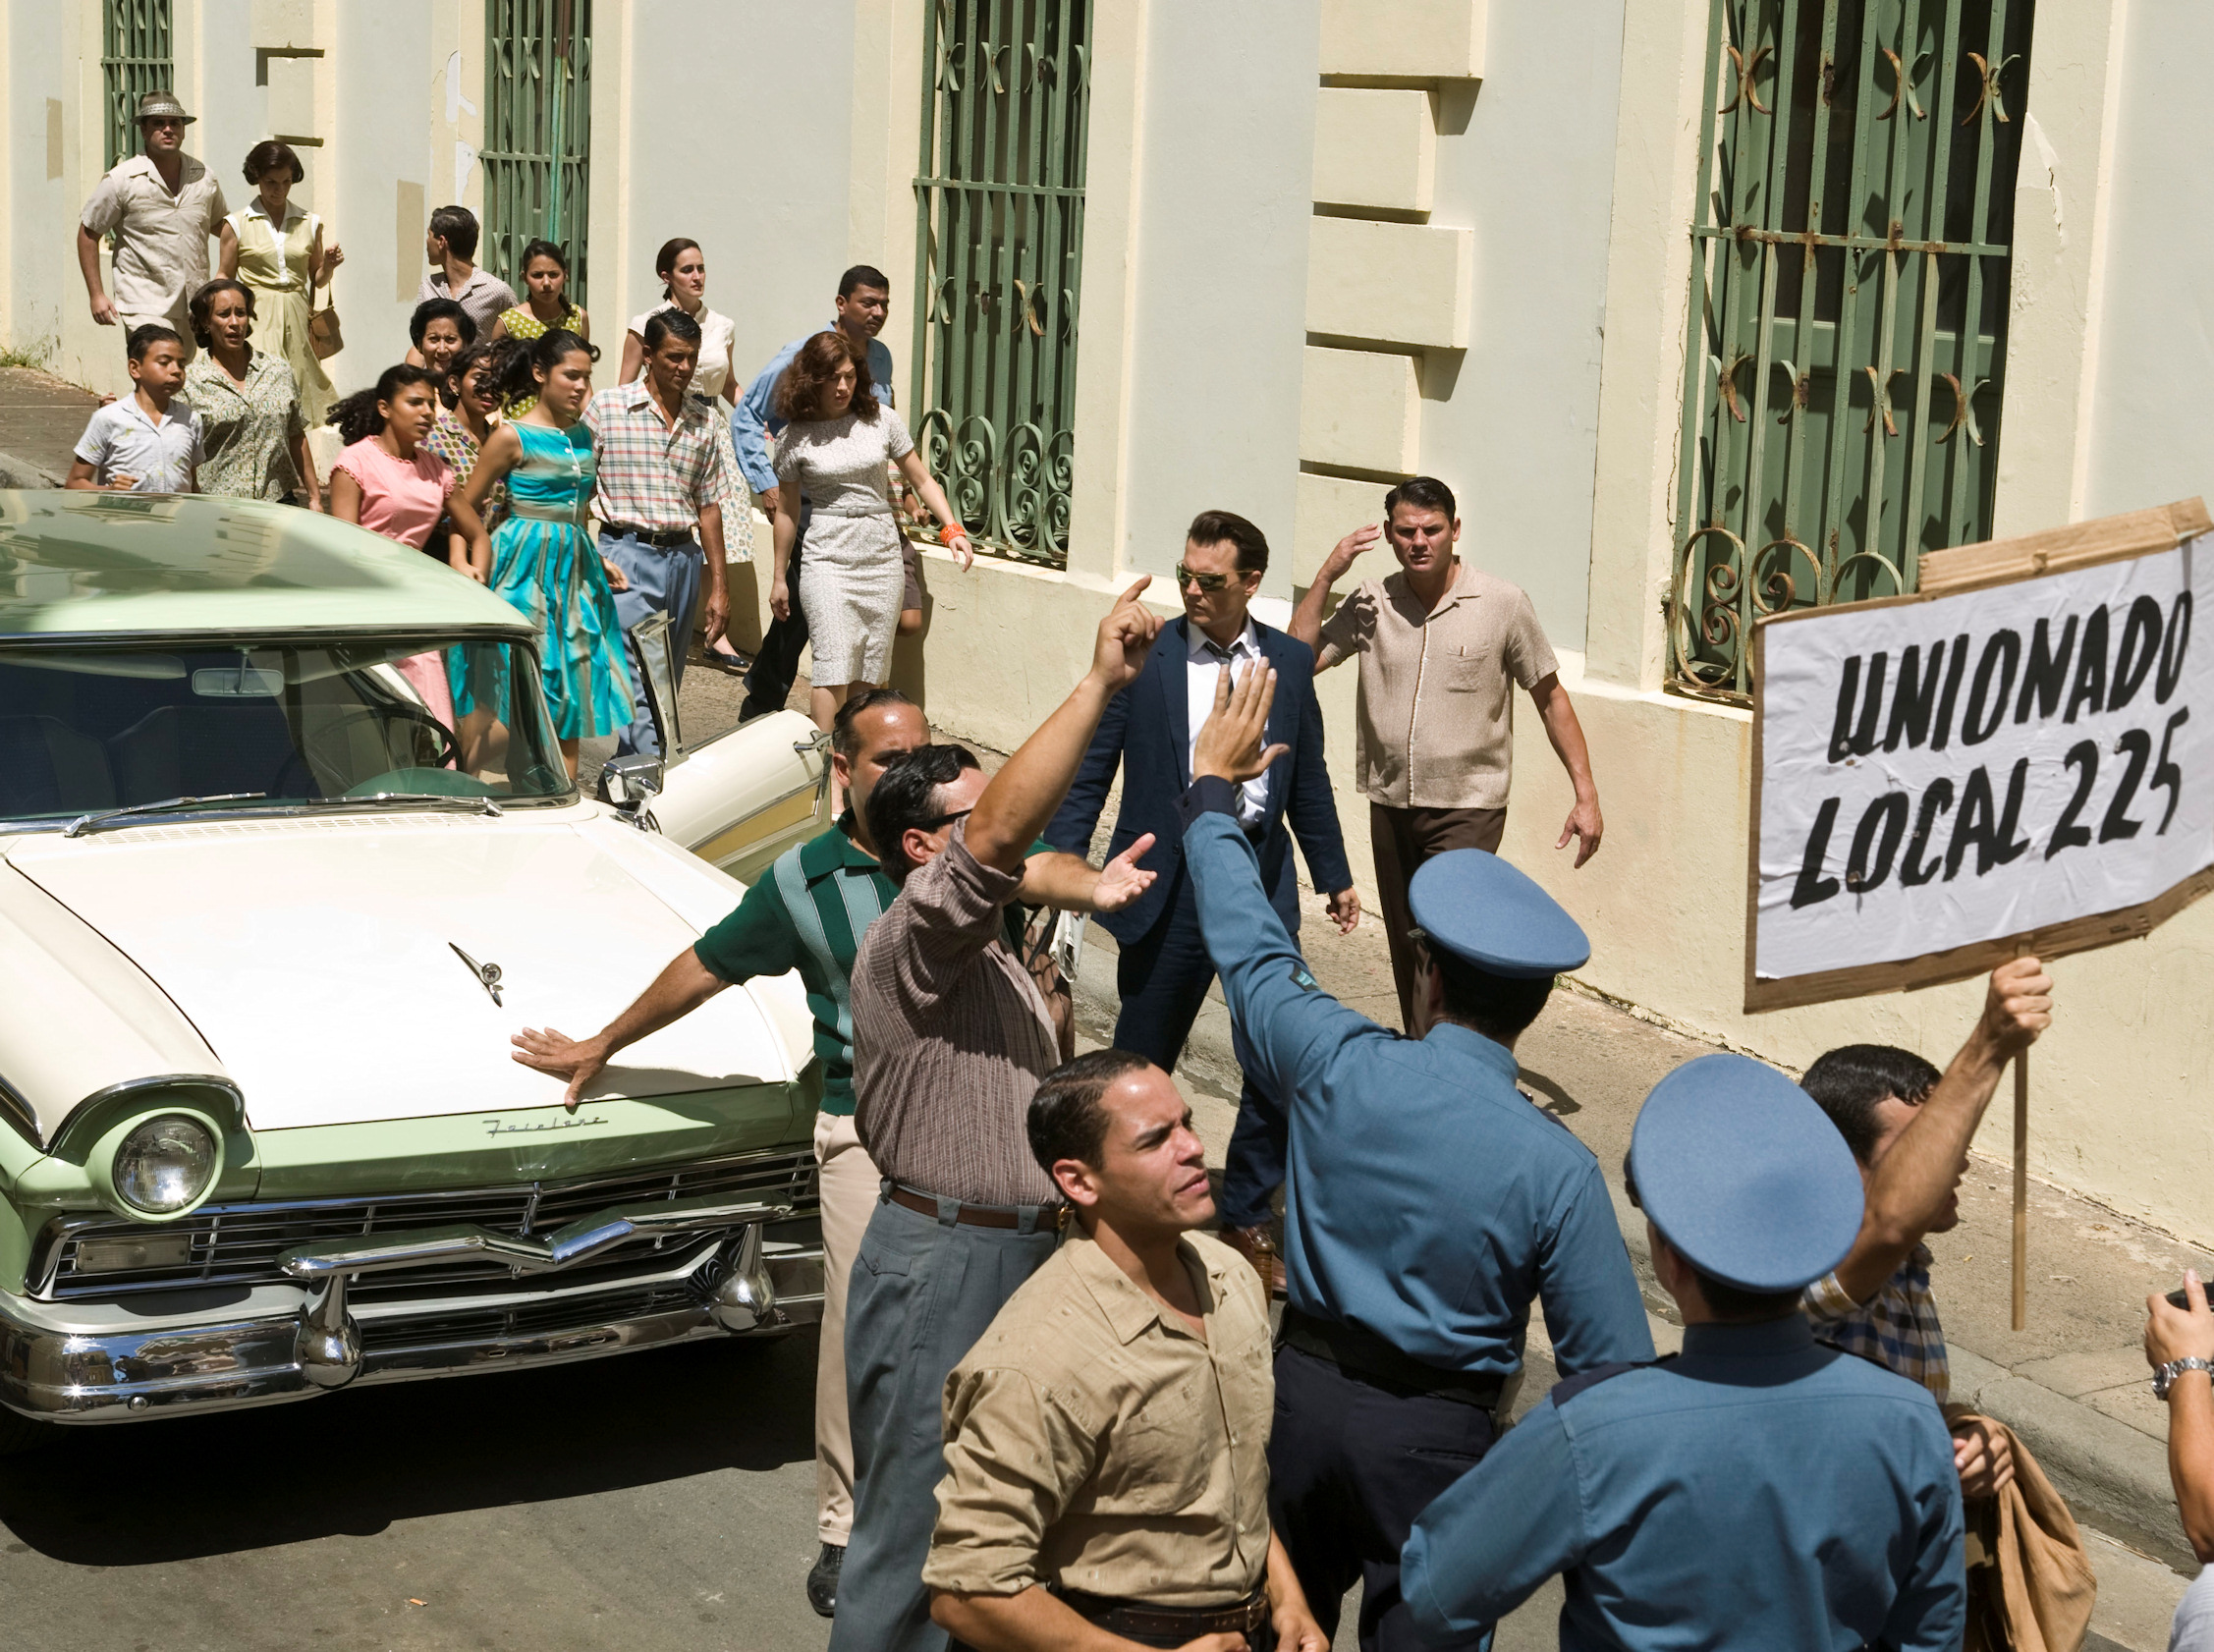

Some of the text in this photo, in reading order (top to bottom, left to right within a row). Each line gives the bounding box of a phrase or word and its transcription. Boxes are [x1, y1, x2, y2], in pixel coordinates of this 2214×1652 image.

[1828, 590, 2192, 763] UNIONADO
[1790, 706, 2188, 909] LOCAL 225
